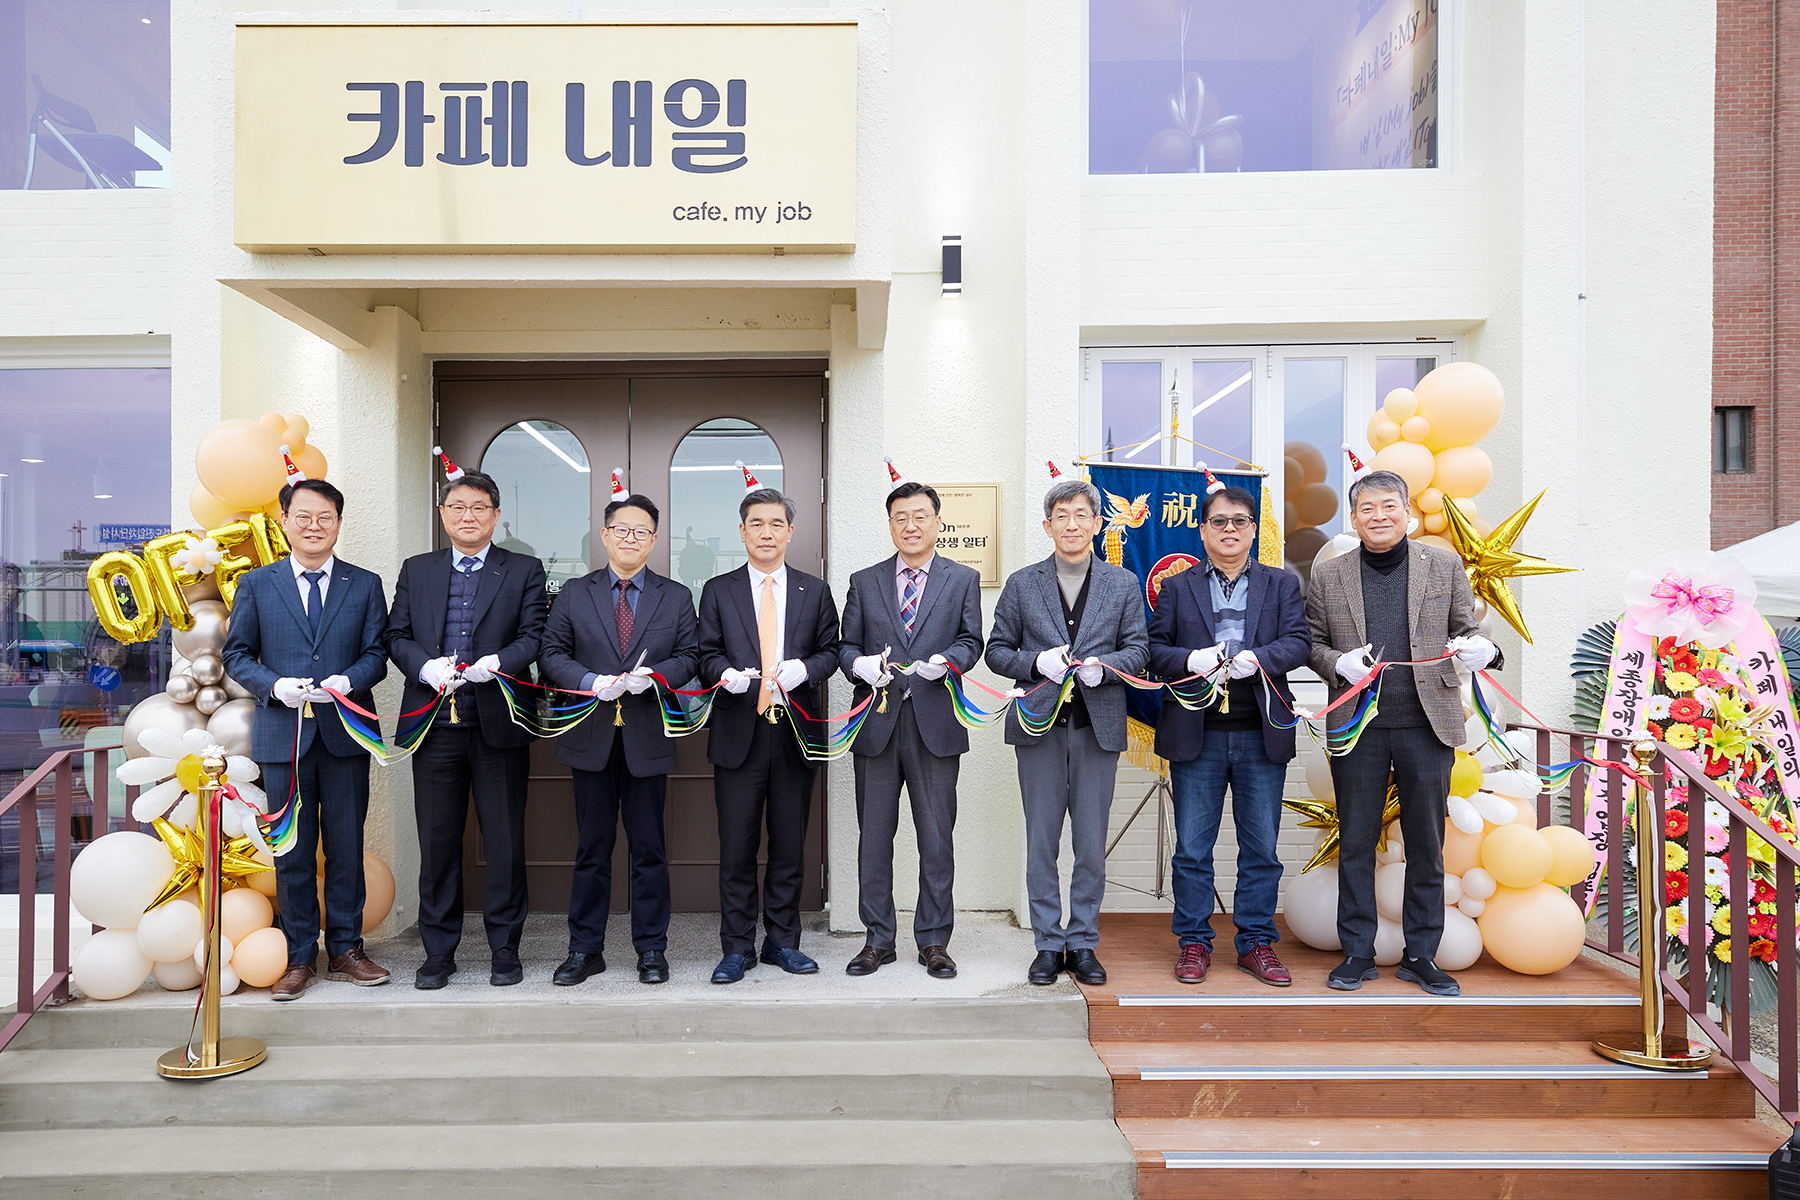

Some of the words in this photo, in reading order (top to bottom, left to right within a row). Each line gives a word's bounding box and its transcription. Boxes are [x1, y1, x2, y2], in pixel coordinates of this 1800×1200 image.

[343, 80, 529, 168] 카페
[565, 78, 748, 174] 내일
[672, 201, 729, 222] cafe.
[734, 205, 768, 225] my
[776, 201, 813, 225] job
[1161, 491, 1199, 529] 祝
[936, 536, 959, 549] 상생
[1748, 651, 1778, 697] 카페
[1768, 709, 1800, 780] 내일의
